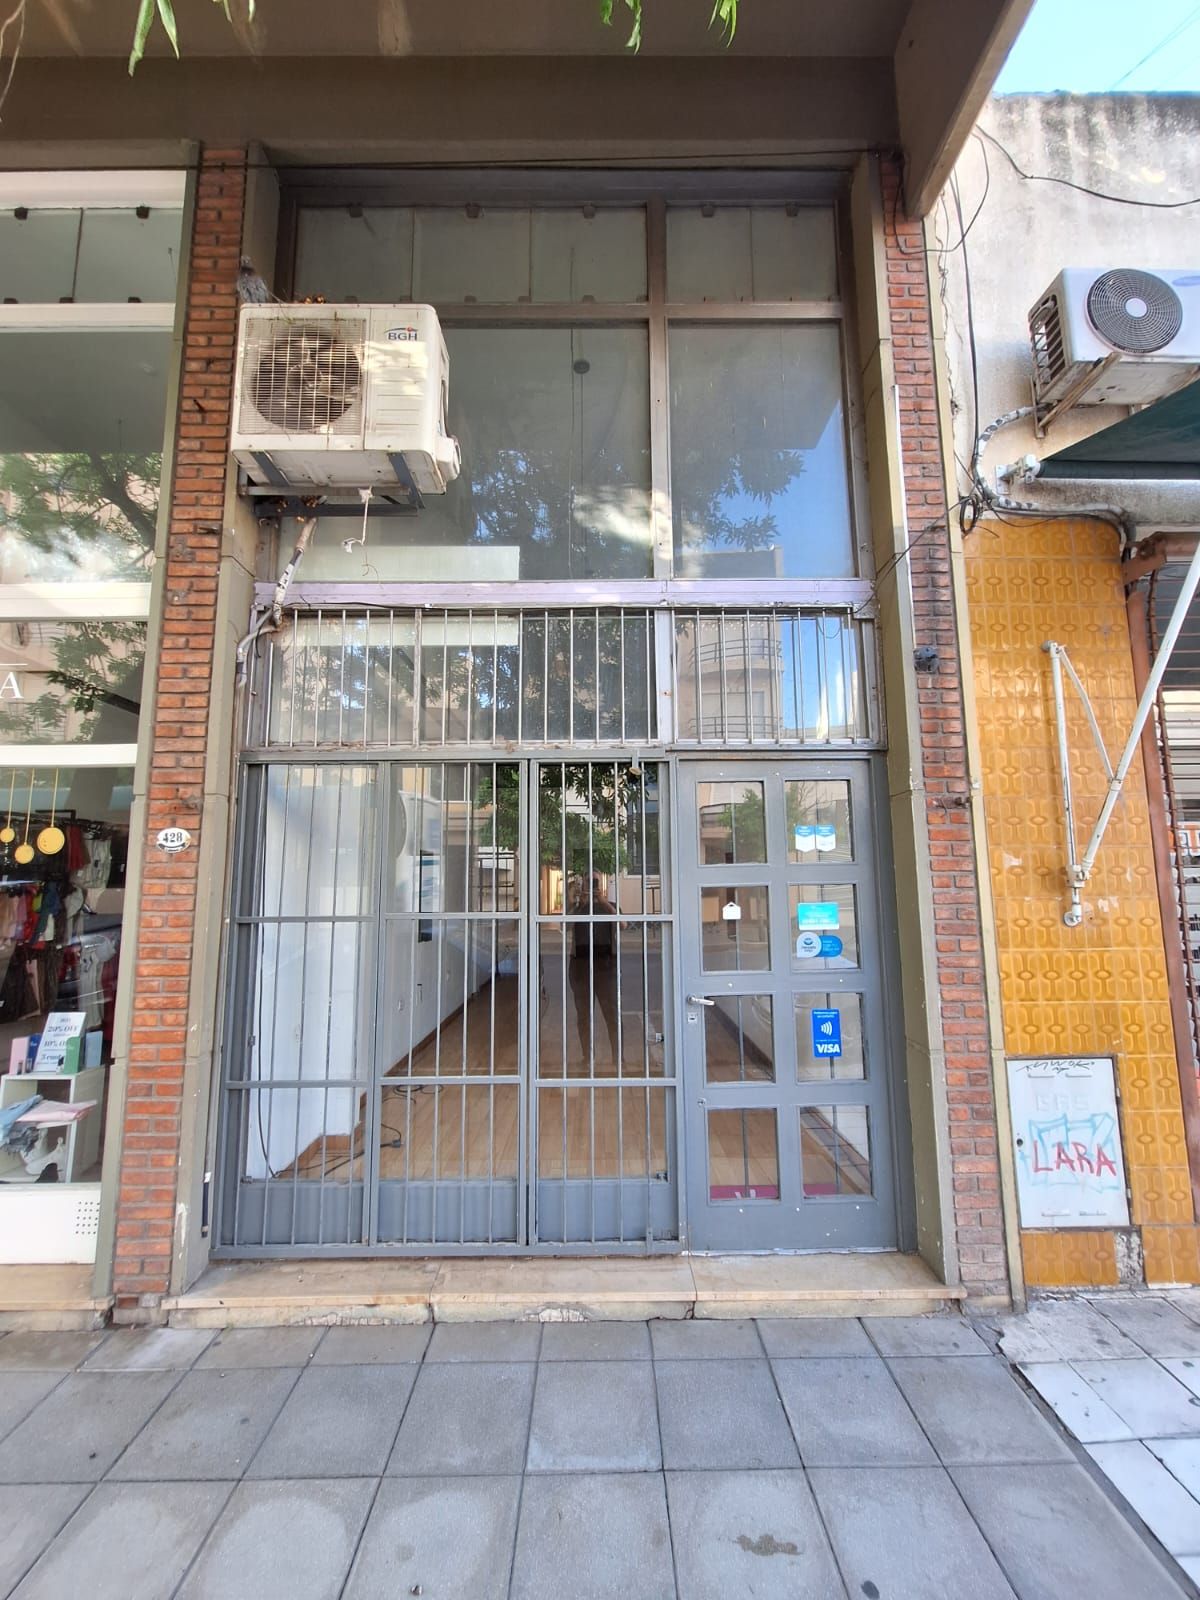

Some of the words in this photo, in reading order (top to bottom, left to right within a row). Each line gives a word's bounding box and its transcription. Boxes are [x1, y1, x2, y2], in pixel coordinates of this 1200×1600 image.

[387, 332, 418, 341] BGH
[162, 832, 183, 843] 428
[815, 1043, 841, 1053] VISA
[1032, 1139, 1117, 1177] LARA
